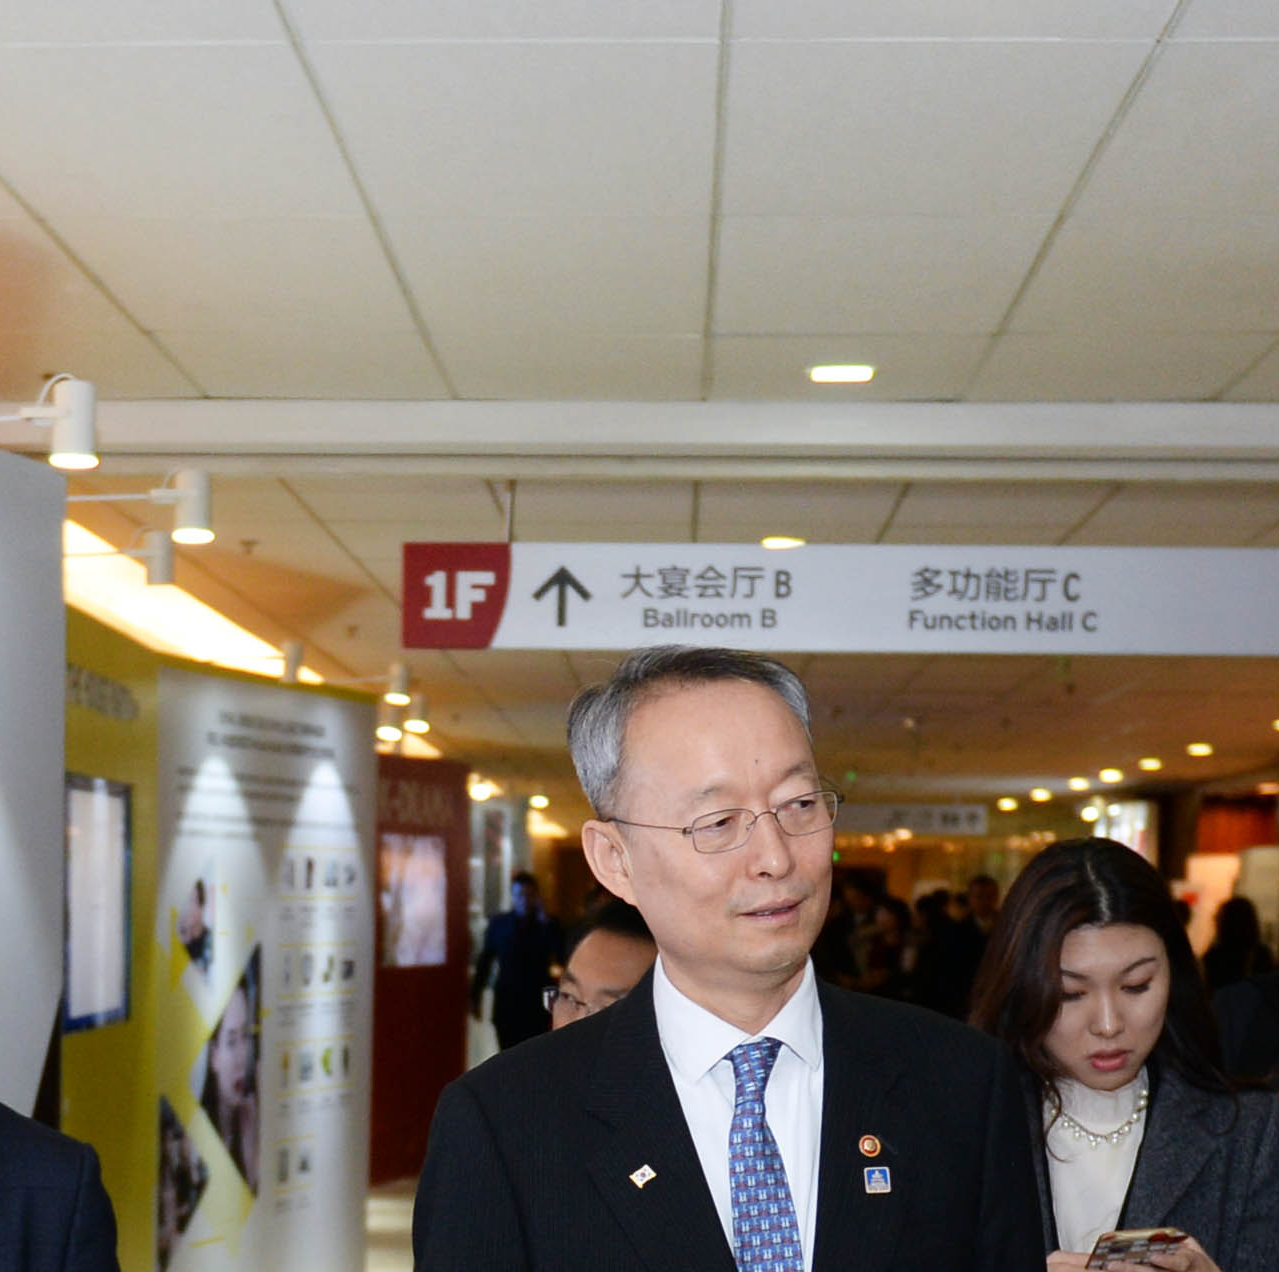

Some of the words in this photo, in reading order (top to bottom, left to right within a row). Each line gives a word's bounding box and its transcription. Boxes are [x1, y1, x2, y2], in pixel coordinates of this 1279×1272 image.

[423, 570, 495, 619] 1F
[642, 608, 752, 628] Ballroom
[761, 608, 777, 628] B
[908, 610, 1017, 631] Function
[1026, 611, 1073, 632] Hall
[1081, 611, 1098, 632] C
